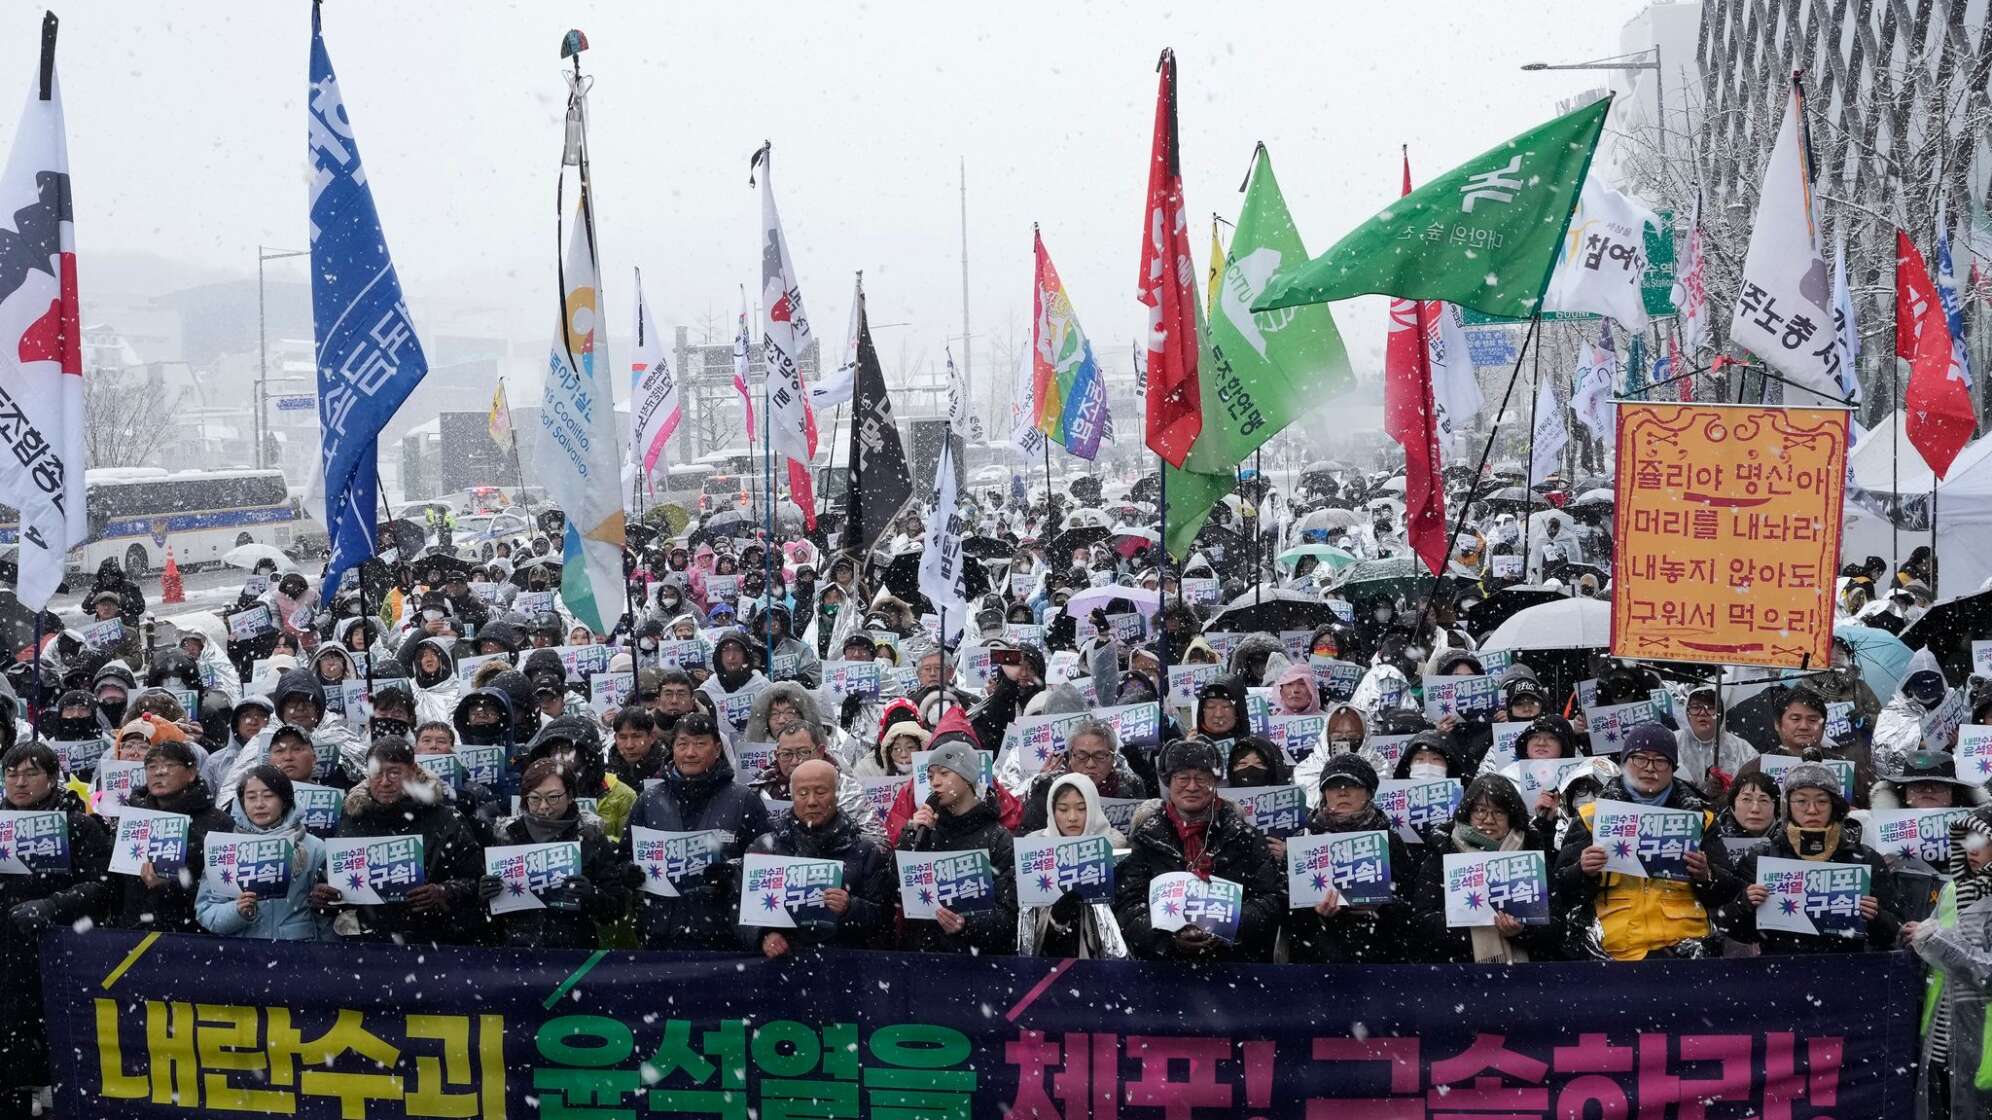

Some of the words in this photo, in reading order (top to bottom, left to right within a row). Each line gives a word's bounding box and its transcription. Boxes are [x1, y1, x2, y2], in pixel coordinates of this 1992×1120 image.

[1738, 279, 1817, 350] 주노총
[1736, 463, 1824, 495] 명신아
[1634, 509, 1718, 540] 머리를
[1733, 513, 1822, 542] 내놔라
[1632, 554, 1715, 584] 내놓지
[1729, 558, 1815, 588] 않아도
[1631, 600, 1715, 628] 구워서
[1729, 603, 1813, 635] 먹으리
[1427, 682, 1454, 693] 내란수괴
[1455, 676, 1500, 699] 체포!
[1456, 692, 1494, 714] 구속!
[1120, 706, 1154, 726] 체포!
[1021, 723, 1052, 737] 내란수괴
[1022, 732, 1052, 748] 윤석열
[1120, 720, 1154, 743] 구속!
[740, 752, 768, 761] 내란수괴
[1376, 743, 1397, 753] 란수괴
[1379, 750, 1397, 760] 석열
[105, 768, 129, 780] 내란수괴
[740, 758, 768, 770] 윤석열
[1256, 788, 1300, 815] 체포!
[1408, 781, 1452, 806] 체포!
[122, 820, 149, 830] 내란수괴
[1256, 808, 1299, 836] 구속!
[1409, 800, 1455, 828] 구속!
[1600, 814, 1639, 825] 내란수괴
[1639, 812, 1694, 838] 체포!
[16, 814, 61, 838] 체포!
[120, 829, 148, 841] 윤석열
[150, 817, 184, 840] 체포!
[1599, 822, 1638, 838] 윤석열
[1880, 818, 1917, 834] 내란동조
[1881, 828, 1918, 844] 국민의힘
[17, 838, 61, 861] 구속!
[149, 840, 181, 863] 구속!
[208, 843, 236, 855] 내란수괴
[238, 840, 286, 864] 체포!
[332, 847, 366, 863] 내란수괴
[366, 838, 415, 867] 체포!
[635, 841, 665, 850] 내란수괴
[636, 849, 665, 861] 윤석열
[1020, 848, 1055, 861] 내란수괴
[1056, 837, 1105, 867] 체포!
[1331, 834, 1380, 865] 체포!
[1638, 836, 1692, 862] 구속!
[208, 853, 236, 868] 윤석열
[333, 857, 366, 875] 윤석열
[491, 854, 524, 870] 내란수괴
[526, 844, 575, 874] 체포!
[903, 862, 932, 874] 내란수괴
[934, 852, 982, 880] 체포!
[1021, 856, 1056, 875] 윤석열
[1295, 855, 1330, 876] 윤석열
[1485, 853, 1538, 883] 체포!
[237, 862, 285, 887] 구속!
[370, 861, 417, 890] 구속!
[748, 867, 785, 880] 내란수괴
[785, 863, 836, 887] 체포!
[904, 872, 934, 888] 윤석열
[1059, 863, 1106, 891] 구속!
[1332, 859, 1383, 889] 구속!
[1449, 863, 1484, 880] 내란수괴
[1449, 872, 1485, 892] 윤석열
[1764, 871, 1804, 882] 내란수괴
[1804, 866, 1862, 893] 체포!
[748, 876, 784, 892] 윤석열
[937, 877, 987, 906] 구속!
[1186, 880, 1234, 902] 체포!
[1488, 879, 1540, 908] 구속!
[784, 886, 826, 913] 구속
[1185, 899, 1232, 923] 구속!
[1805, 892, 1862, 919] 구속!
[94, 998, 506, 1120] 내란수괴
[534, 1015, 977, 1120] 윤석열을
[1003, 1030, 1276, 1120] 체포!
